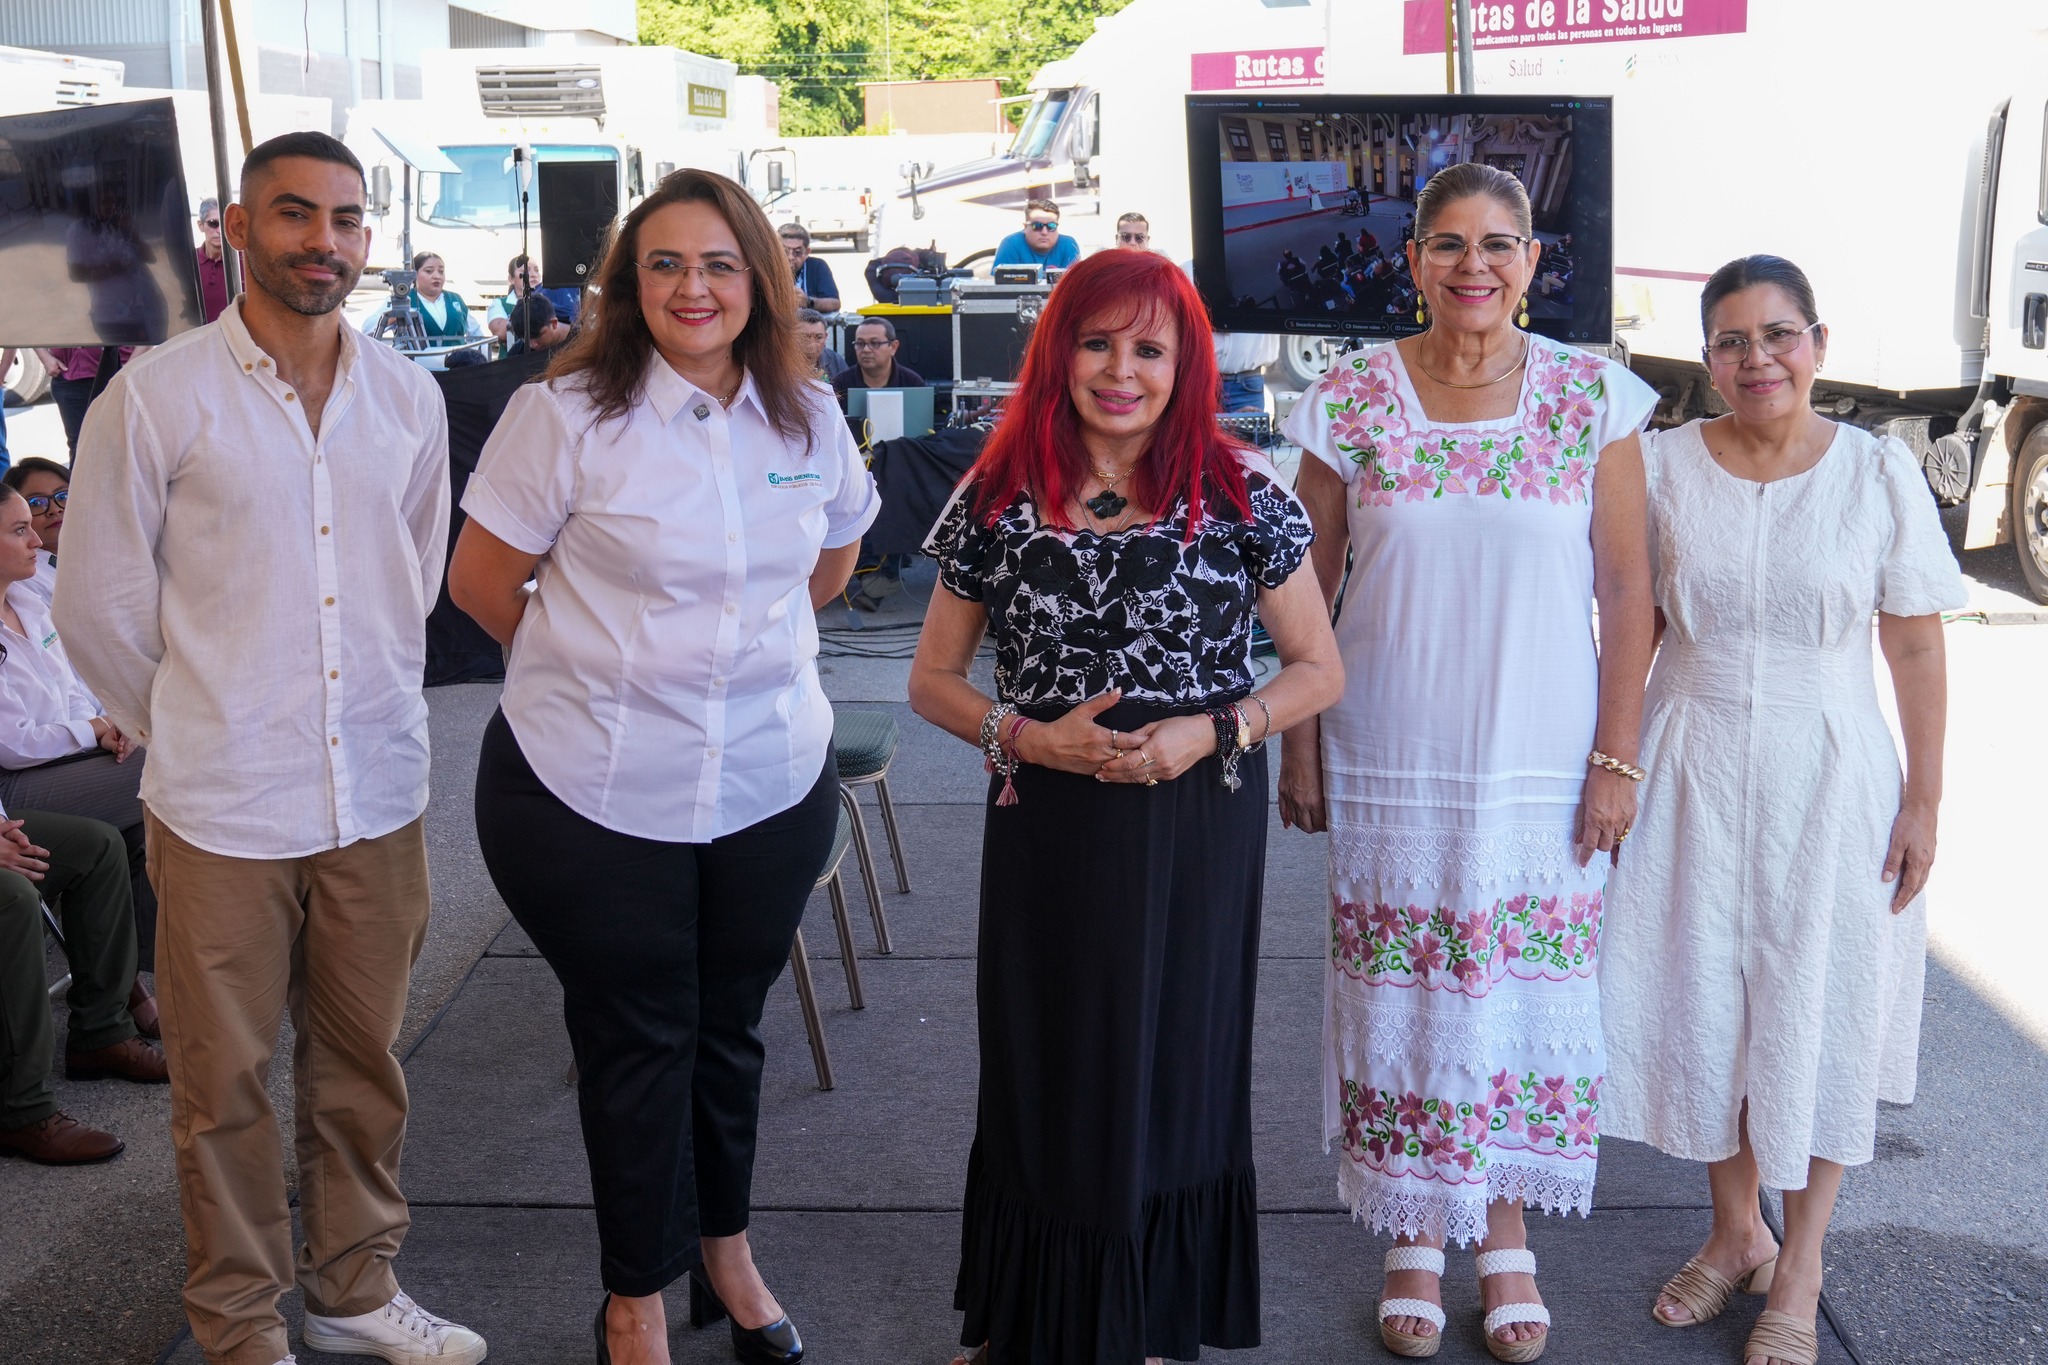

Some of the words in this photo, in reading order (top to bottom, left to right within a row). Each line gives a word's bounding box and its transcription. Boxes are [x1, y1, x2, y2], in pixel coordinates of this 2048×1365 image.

[1452, 2, 1514, 33] tas
[1525, 0, 1556, 28] de
[1566, 0, 1590, 26] la
[1602, 0, 1684, 23] Salud
[1476, 35, 1519, 45] medicamento
[1520, 33, 1536, 44] para
[1537, 31, 1556, 41] todas
[1558, 30, 1568, 40] las
[1570, 28, 1602, 41] personas
[1604, 28, 1614, 37] en
[1616, 25, 1637, 36] todos
[1639, 24, 1651, 35] los
[1653, 23, 1683, 36] lugares
[1235, 55, 1305, 78] Rutas
[1509, 58, 1543, 77] Salud
